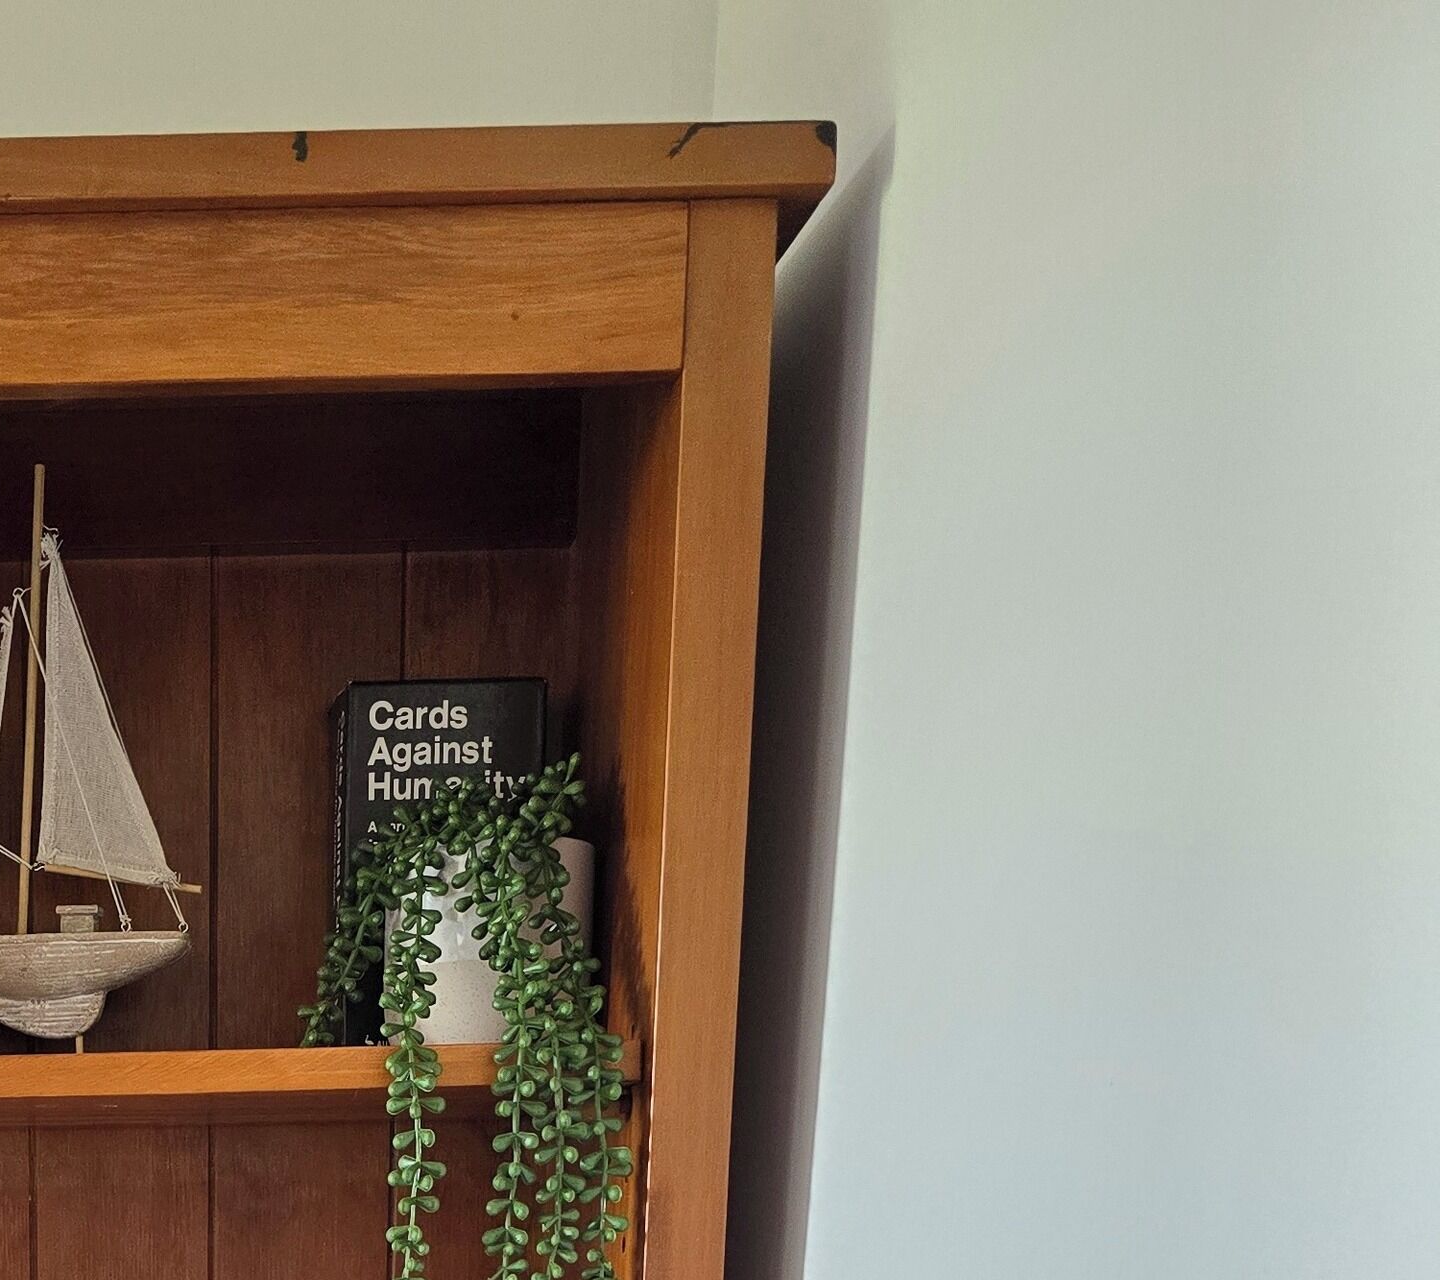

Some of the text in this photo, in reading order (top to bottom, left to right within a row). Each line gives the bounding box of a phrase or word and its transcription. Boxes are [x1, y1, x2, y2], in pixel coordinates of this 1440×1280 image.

[368, 700, 468, 730] Cards
[367, 735, 493, 772] Against
[368, 770, 526, 801] Humty
